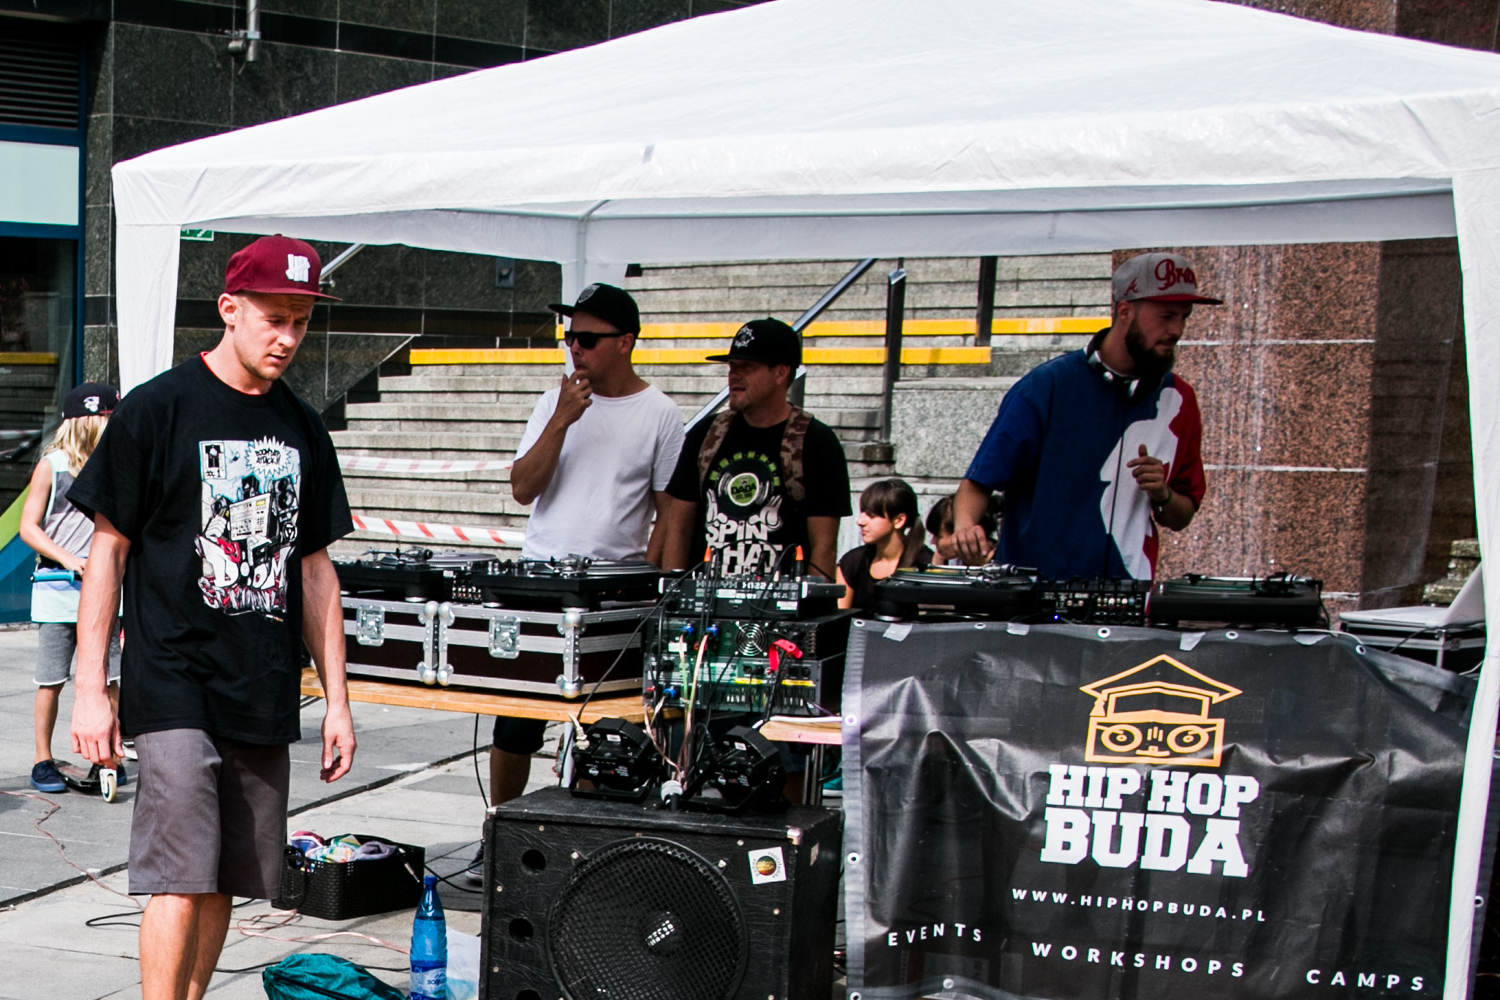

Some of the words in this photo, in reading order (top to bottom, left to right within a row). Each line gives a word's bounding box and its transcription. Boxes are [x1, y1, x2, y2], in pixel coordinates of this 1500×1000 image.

[1046, 763, 1142, 809] HIP
[1147, 769, 1260, 817] HOP
[1040, 807, 1249, 878] BUDA
[1012, 888, 1266, 922] WWW.HIPHOPBUDA.PL
[888, 923, 982, 946] EVENTS
[1032, 942, 1244, 978] WORKSHOPS
[1305, 969, 1424, 991] CAMPS
